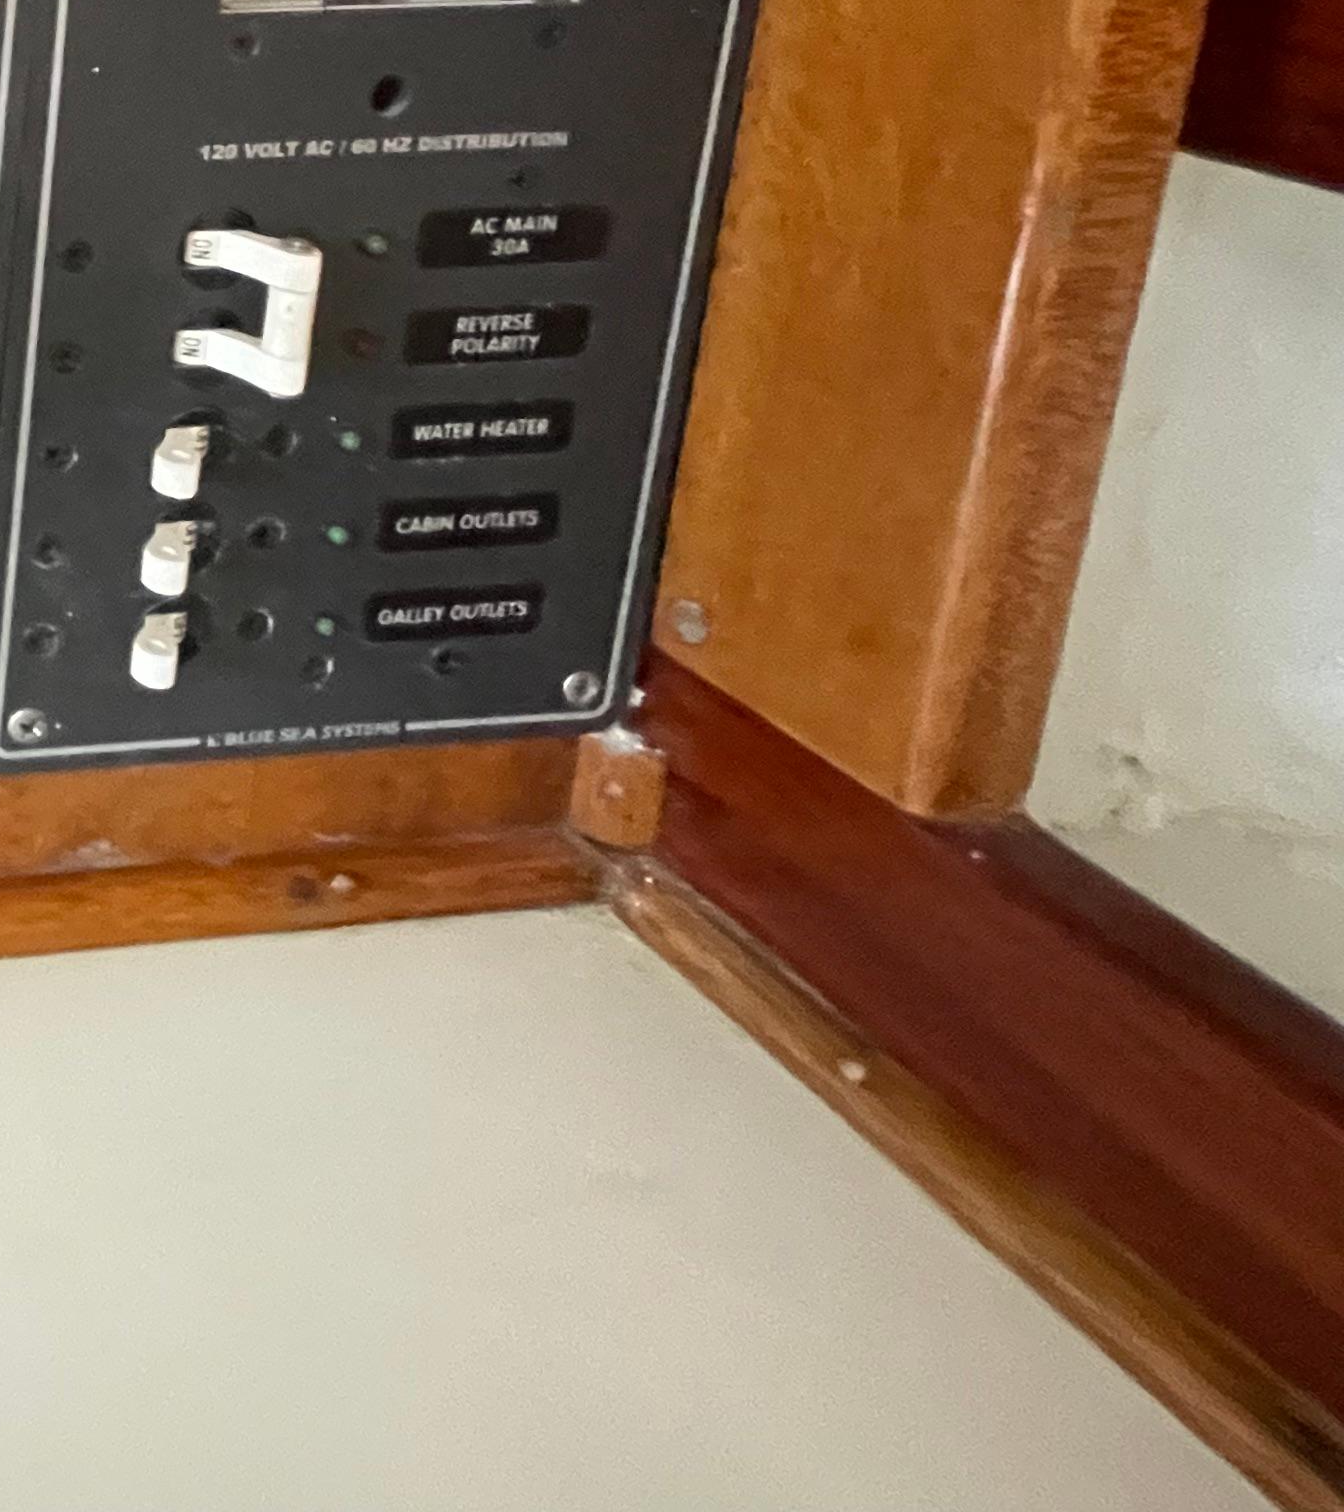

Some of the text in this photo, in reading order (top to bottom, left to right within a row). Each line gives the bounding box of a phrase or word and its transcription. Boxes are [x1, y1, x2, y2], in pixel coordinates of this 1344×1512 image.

[200, 144, 239, 161] 120
[244, 141, 298, 158] VOLT
[305, 139, 335, 156] AC
[382, 136, 414, 153] HZ
[417, 132, 569, 152] DISTRIBUTION
[471, 215, 557, 234] AC MAIN
[191, 239, 212, 259] ON
[456, 313, 533, 332] REVERSE
[182, 337, 201, 357] ON
[451, 335, 540, 354] POLARITY
[414, 418, 548, 440] WATER HEATER
[396, 510, 538, 534] CABIN OUTLETS
[378, 601, 527, 625] GALLEY OUTLETS
[321, 722, 400, 739] SYSTEMS
